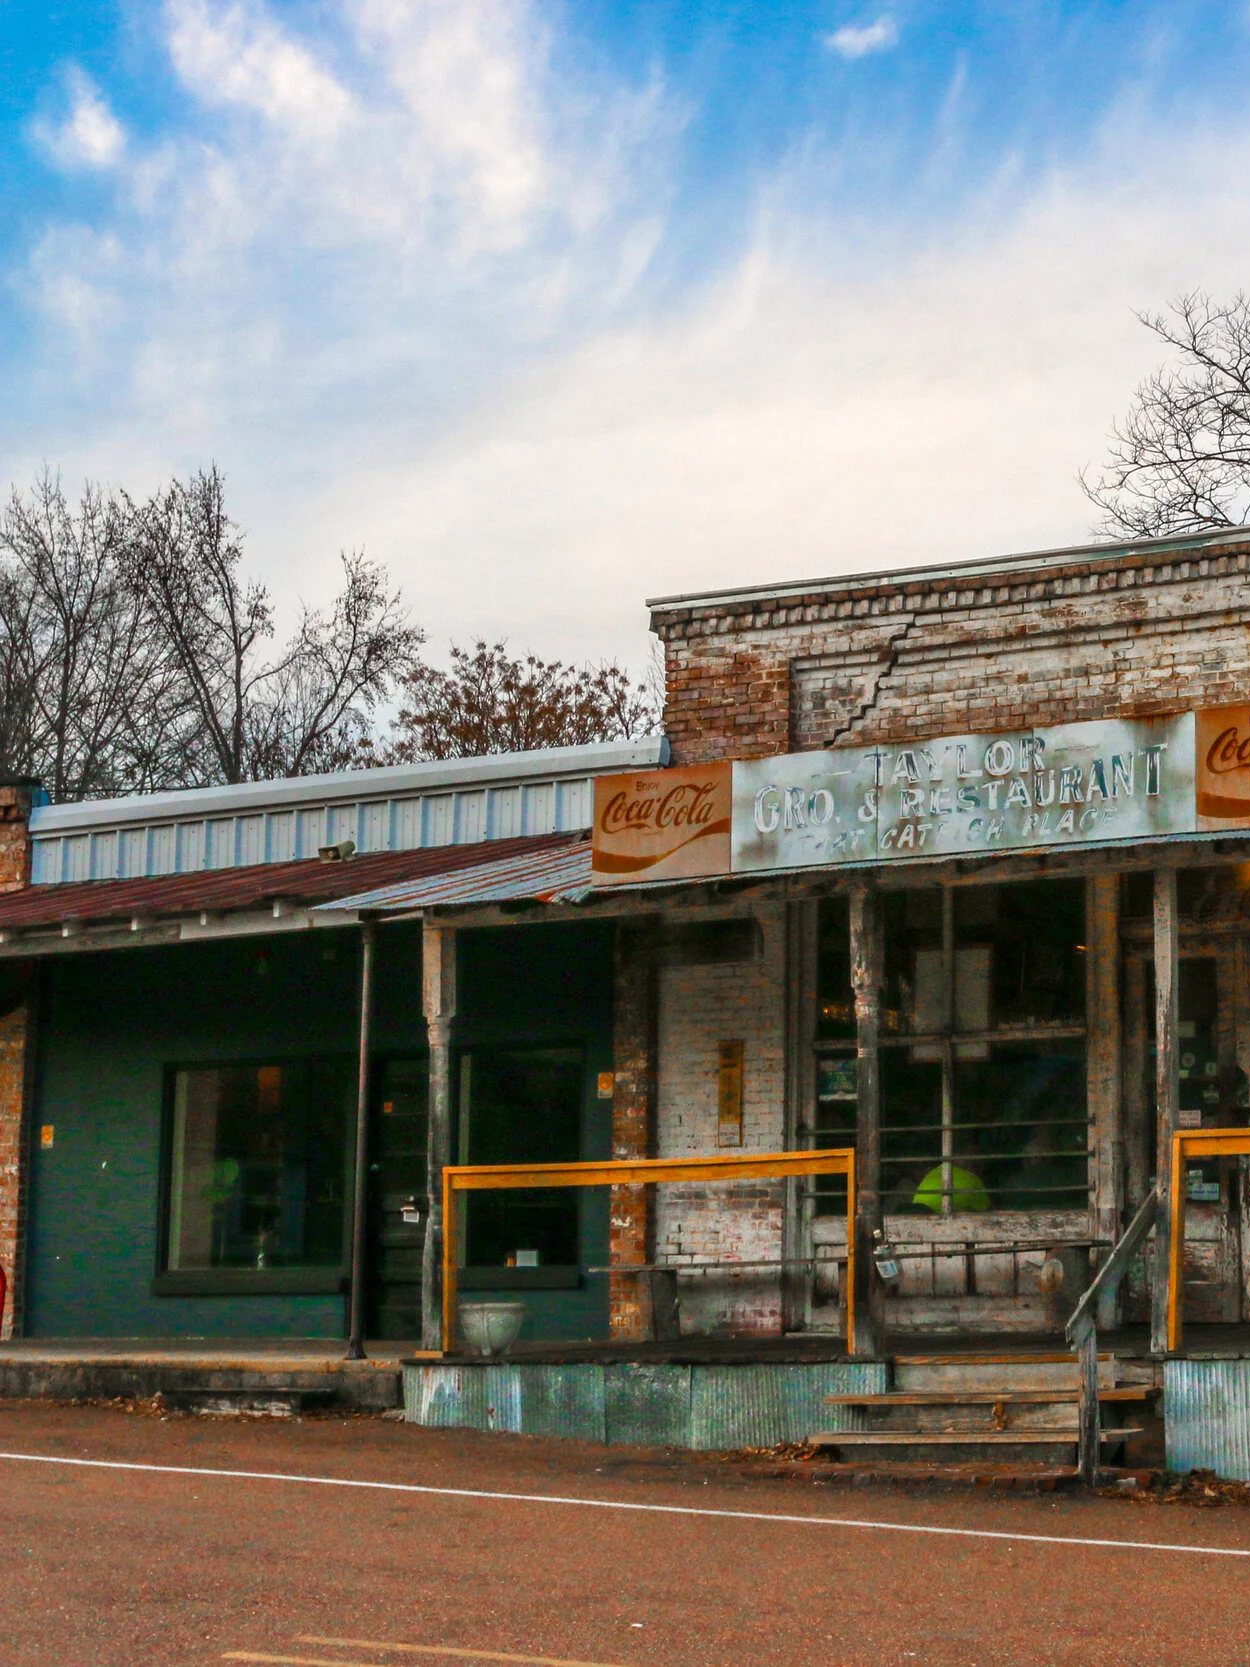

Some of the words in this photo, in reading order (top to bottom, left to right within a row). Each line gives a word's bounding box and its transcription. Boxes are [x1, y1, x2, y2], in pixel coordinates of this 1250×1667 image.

[864, 737, 1046, 786] TAYLOR
[601, 780, 720, 834] Coca-Cola
[635, 780, 660, 793] Enjoy
[754, 784, 842, 833] GRO.
[857, 789, 882, 823] &
[899, 743, 1168, 819] RESTAURANT
[1022, 807, 1117, 837] PLACE
